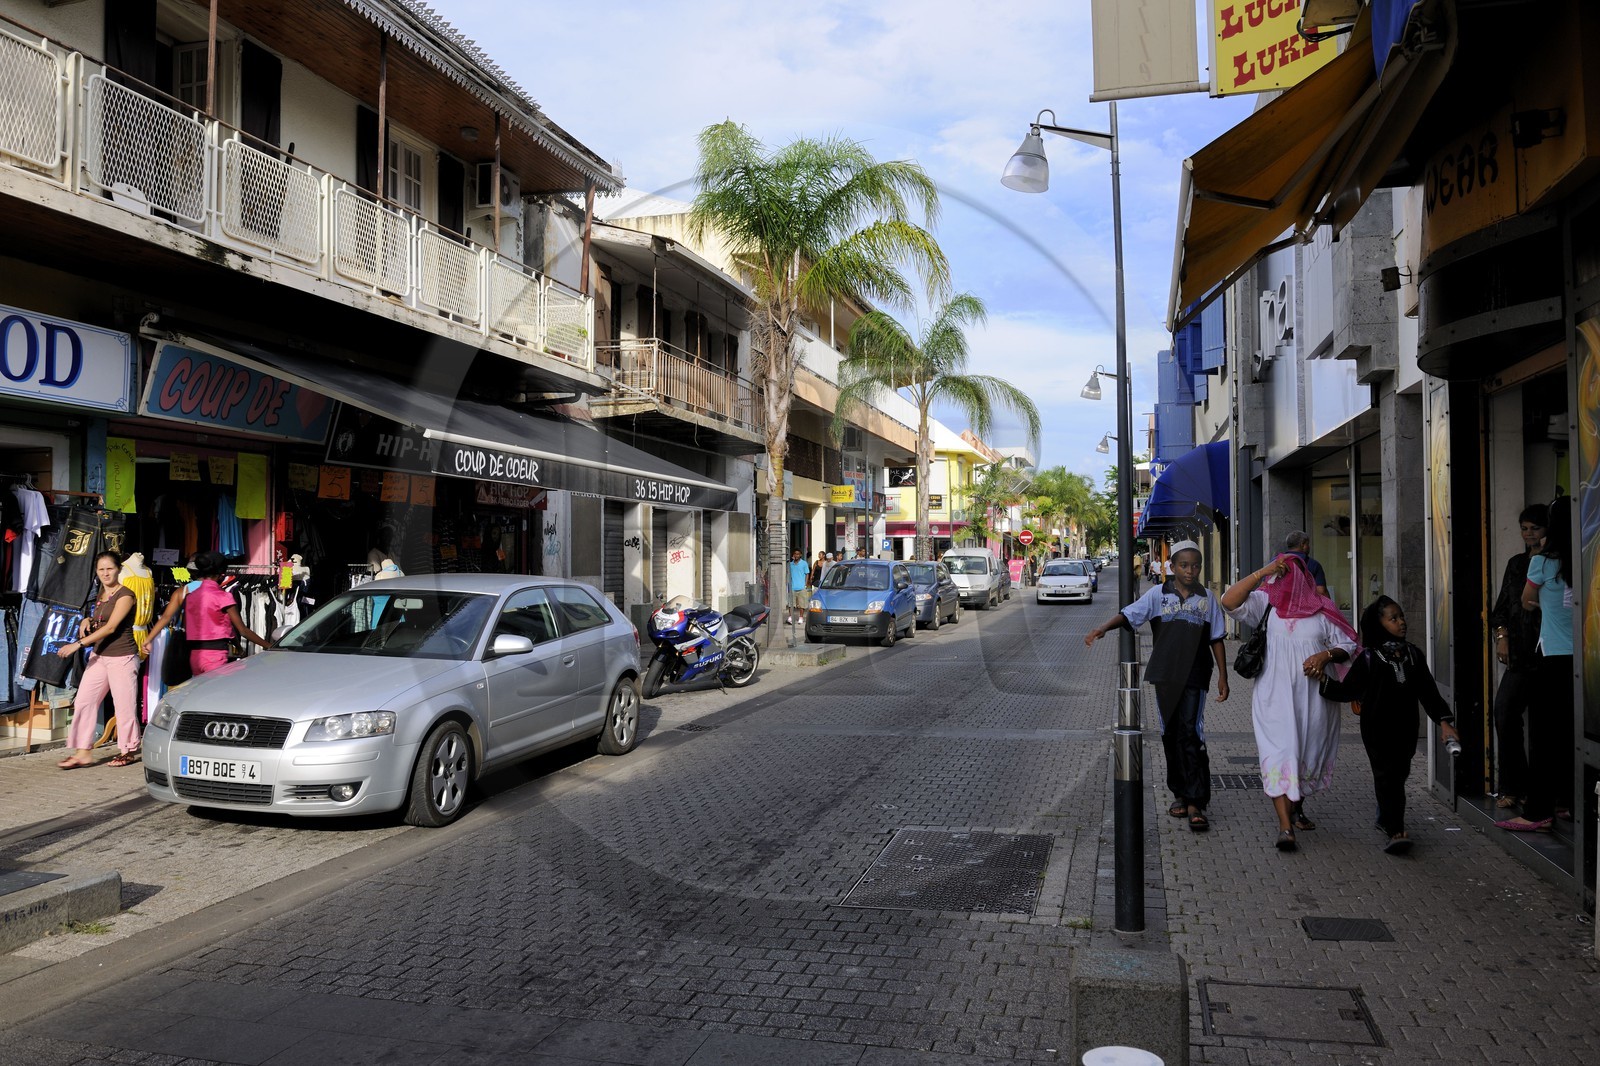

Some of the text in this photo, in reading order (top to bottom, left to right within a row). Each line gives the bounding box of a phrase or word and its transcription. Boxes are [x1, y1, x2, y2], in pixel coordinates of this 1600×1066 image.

[1425, 132, 1498, 216] WEAR
[159, 357, 291, 427] COUP DE
[454, 448, 540, 484] COUP DE COEUR
[489, 481, 530, 498] HIP HOP
[635, 479, 691, 503] 36 15 HIP HOP
[692, 652, 724, 670] SUZUKI
[188, 758, 210, 776] 897
[213, 761, 236, 779] BQE
